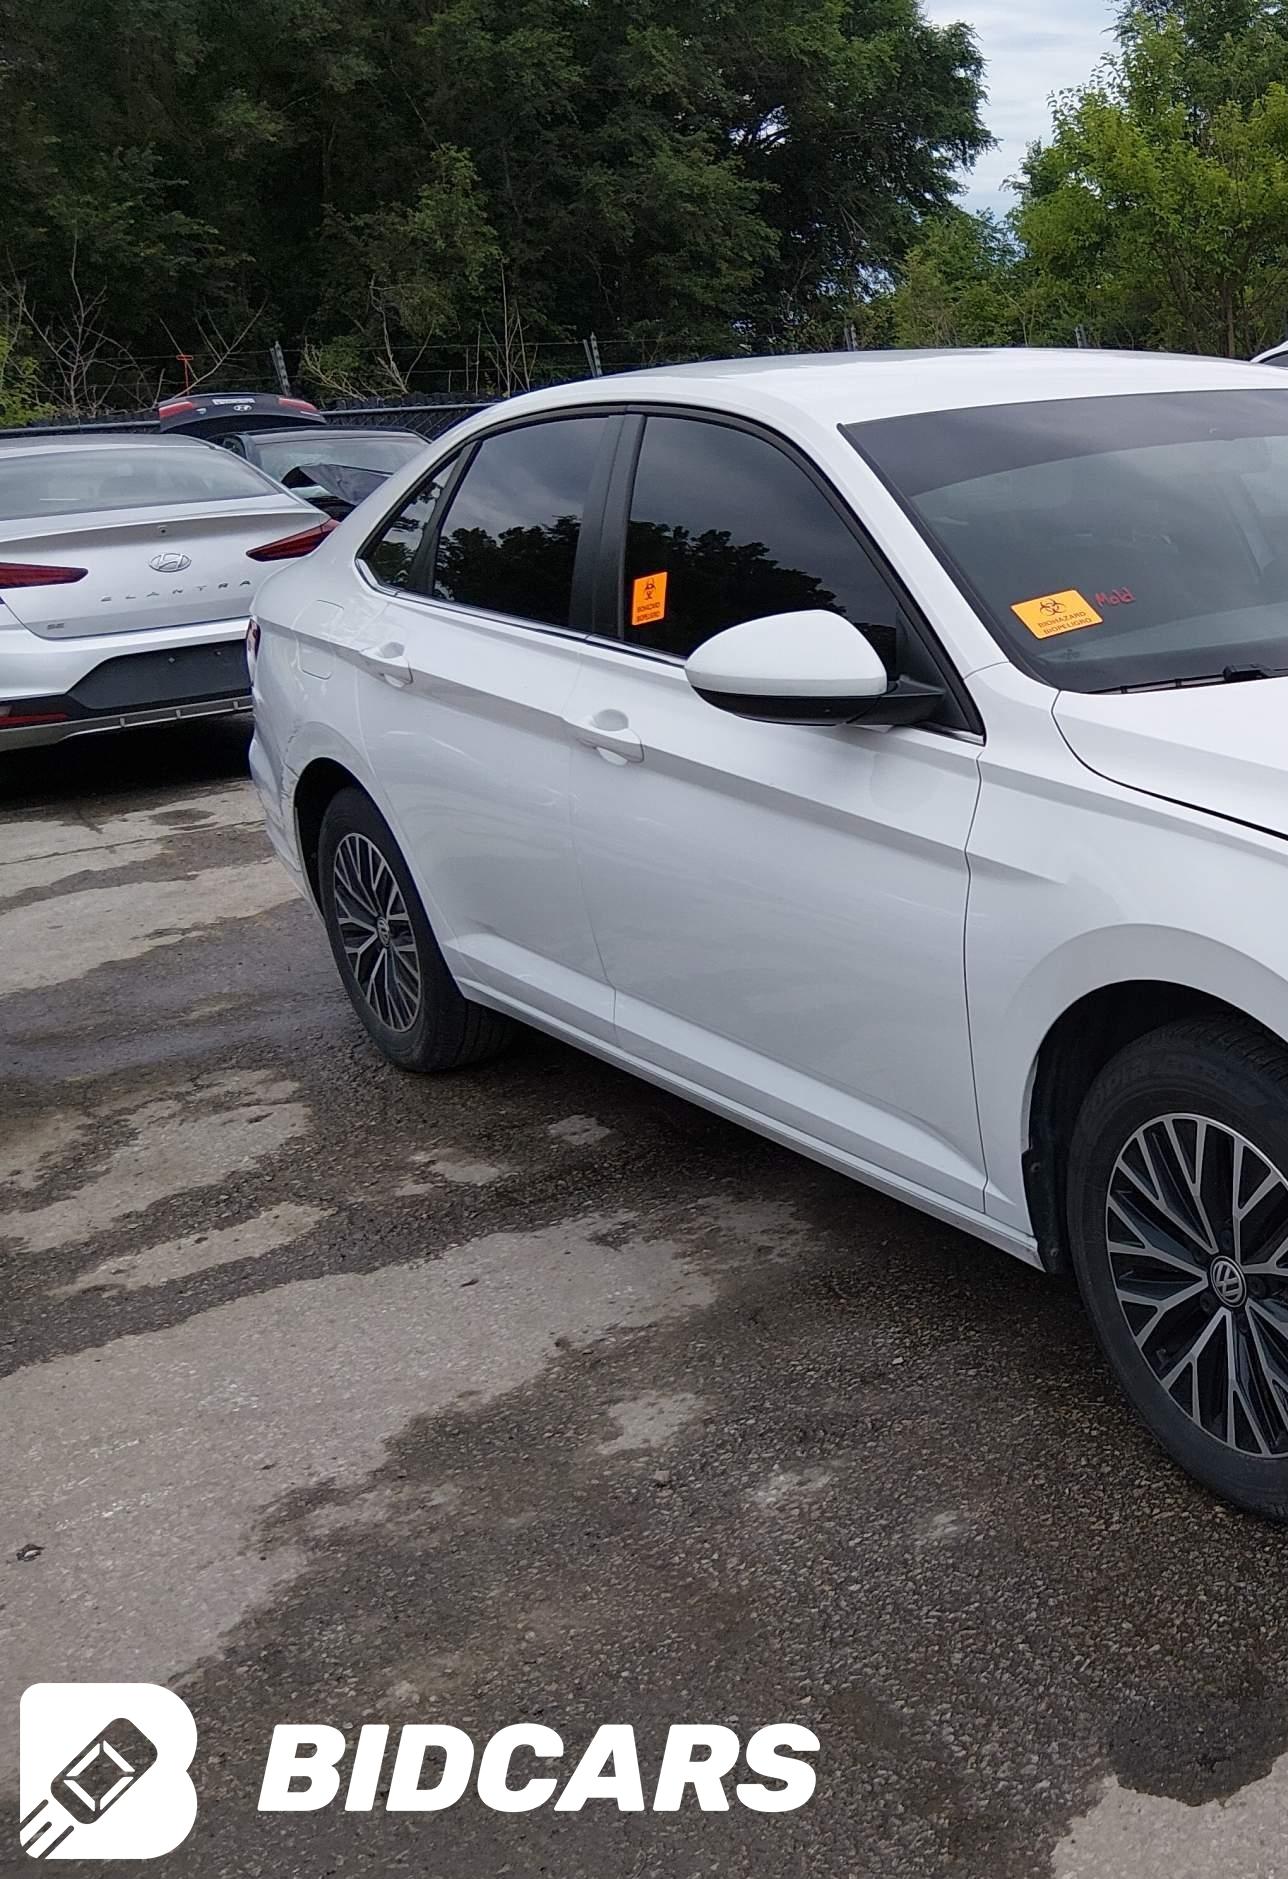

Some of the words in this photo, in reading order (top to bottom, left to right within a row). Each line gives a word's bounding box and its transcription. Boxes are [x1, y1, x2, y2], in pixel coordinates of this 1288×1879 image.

[100, 580, 251, 602] ELANTRA
[1037, 611, 1087, 628] BIOHAZARD
[1043, 617, 1092, 635] BIOPELIGRO
